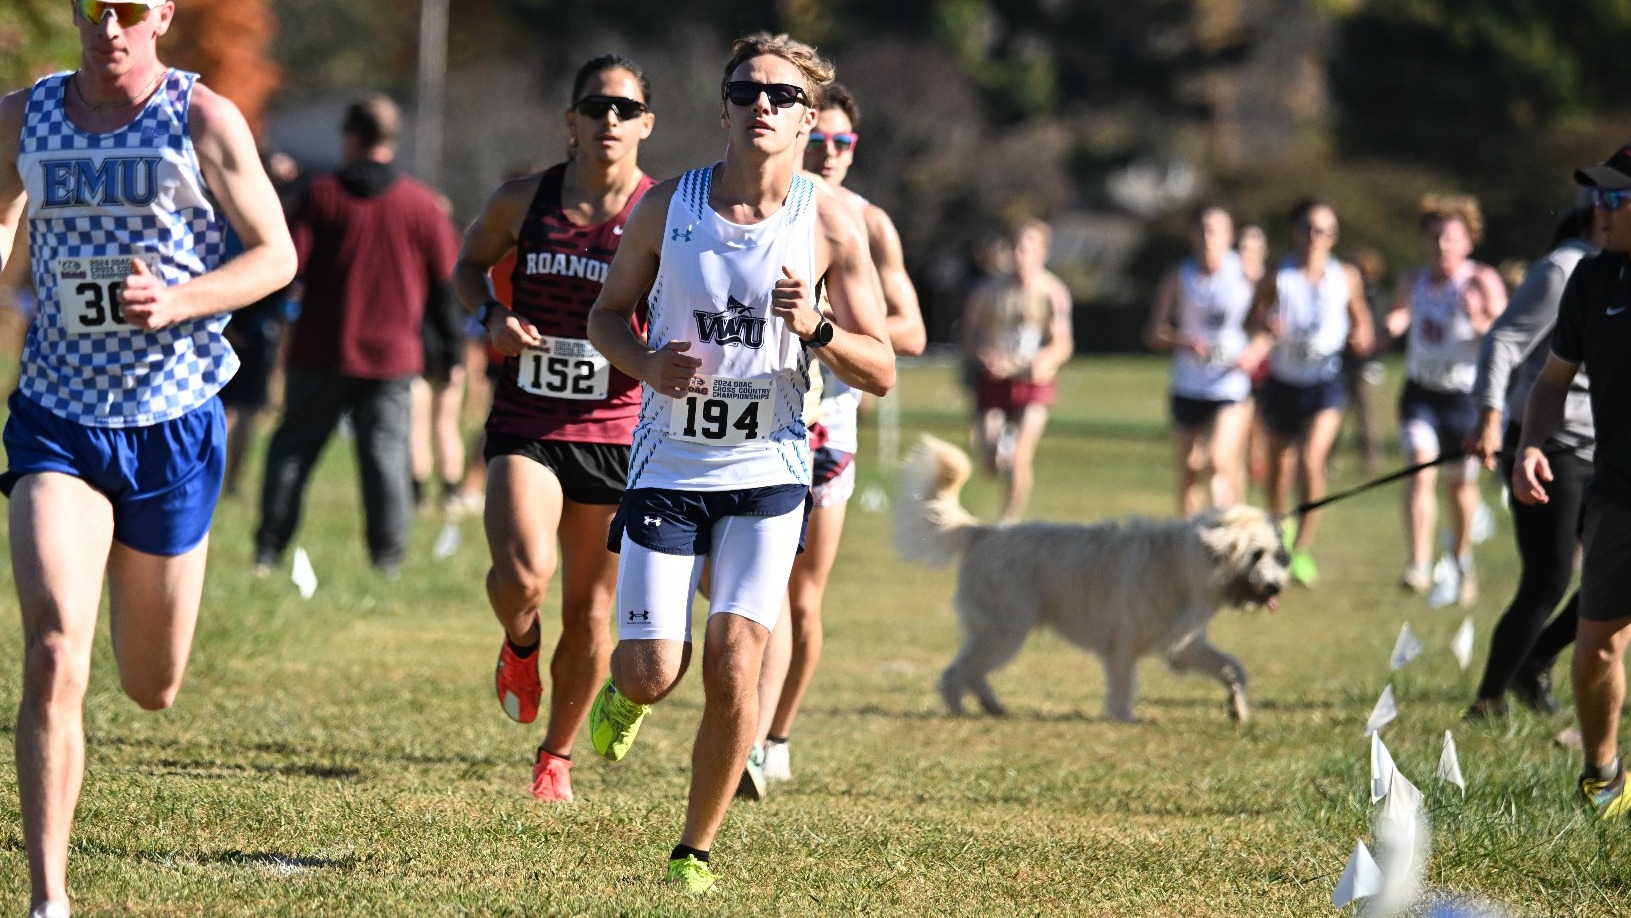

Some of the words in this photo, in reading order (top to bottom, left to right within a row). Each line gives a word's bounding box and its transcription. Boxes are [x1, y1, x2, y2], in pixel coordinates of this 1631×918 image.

[39, 157, 163, 210] EMU
[531, 354, 595, 394] 152
[713, 379, 732, 387] 2024
[688, 387, 708, 395] DAC
[713, 386, 736, 394] CROSS
[739, 387, 771, 395] COUNTRY
[683, 396, 759, 440] 194
